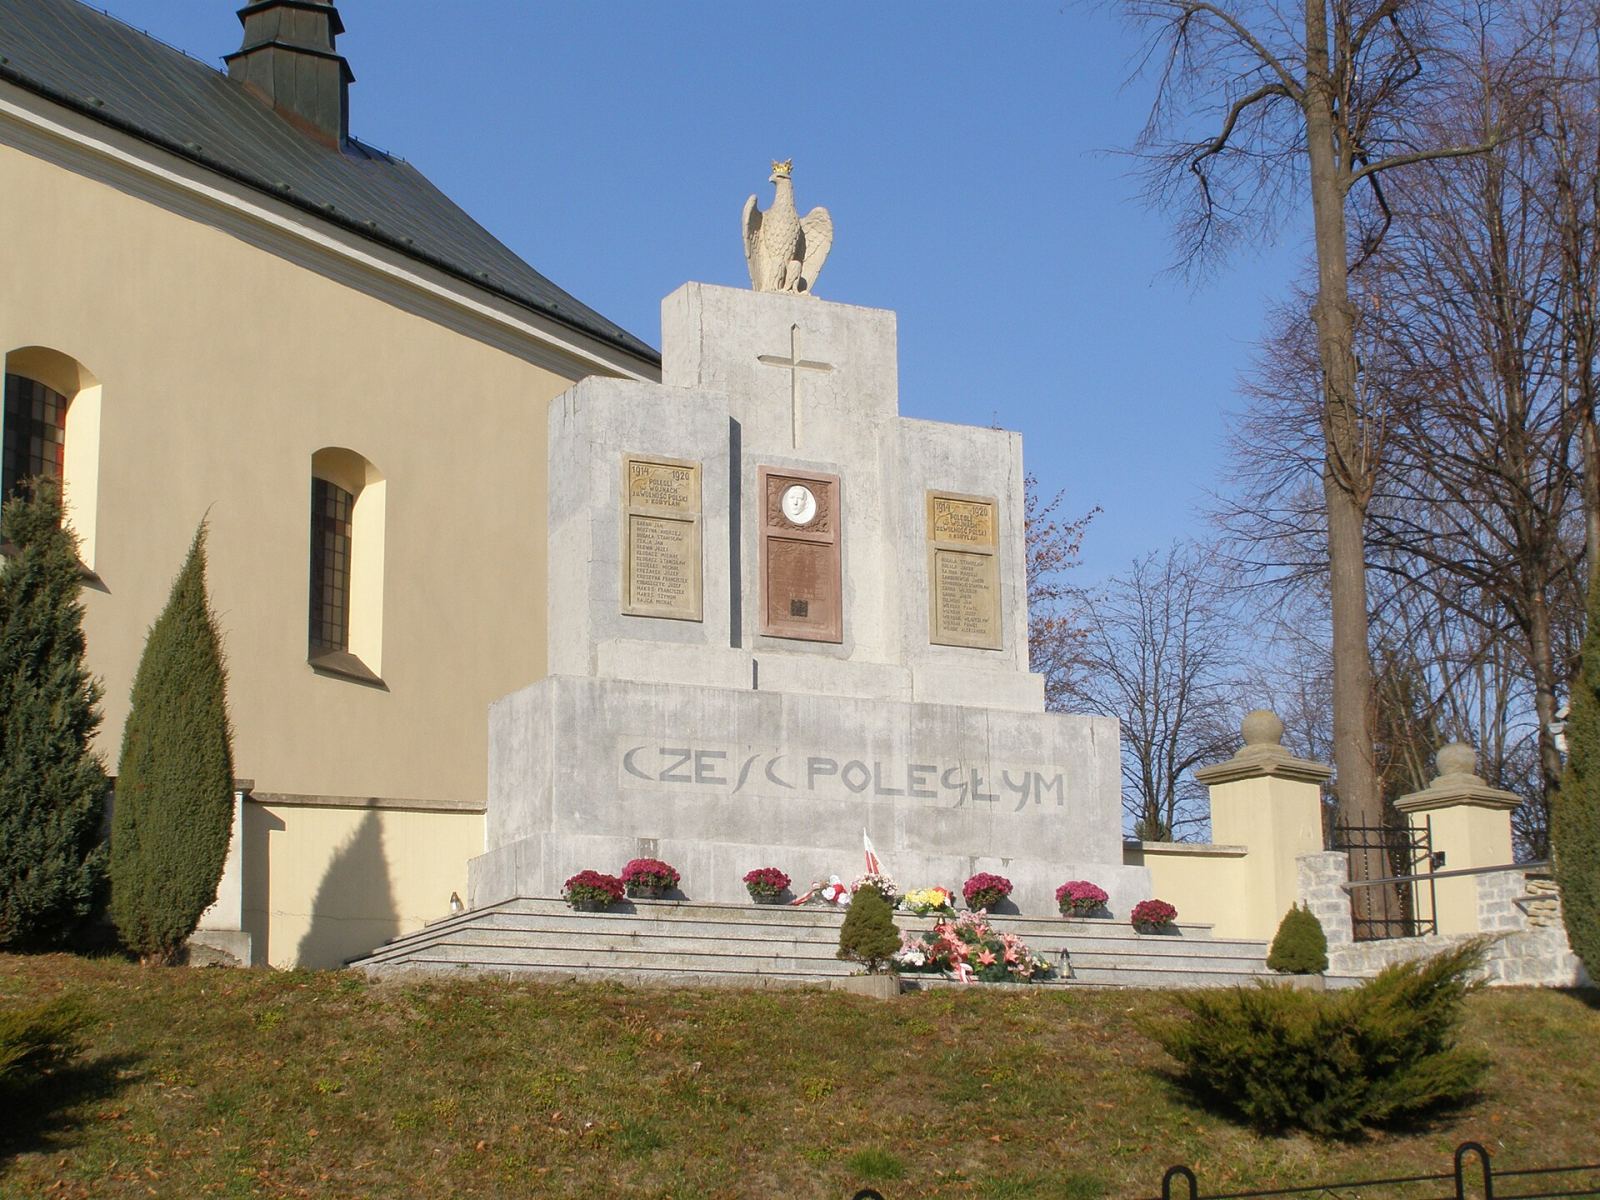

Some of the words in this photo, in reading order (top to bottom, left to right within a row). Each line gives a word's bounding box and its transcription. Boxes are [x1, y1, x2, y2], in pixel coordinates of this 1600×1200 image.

[632, 465, 649, 477] 1914
[672, 470, 689, 481] 1920
[623, 745, 796, 794] CZEŚĆ
[807, 757, 1064, 812] POLEGŁYM
